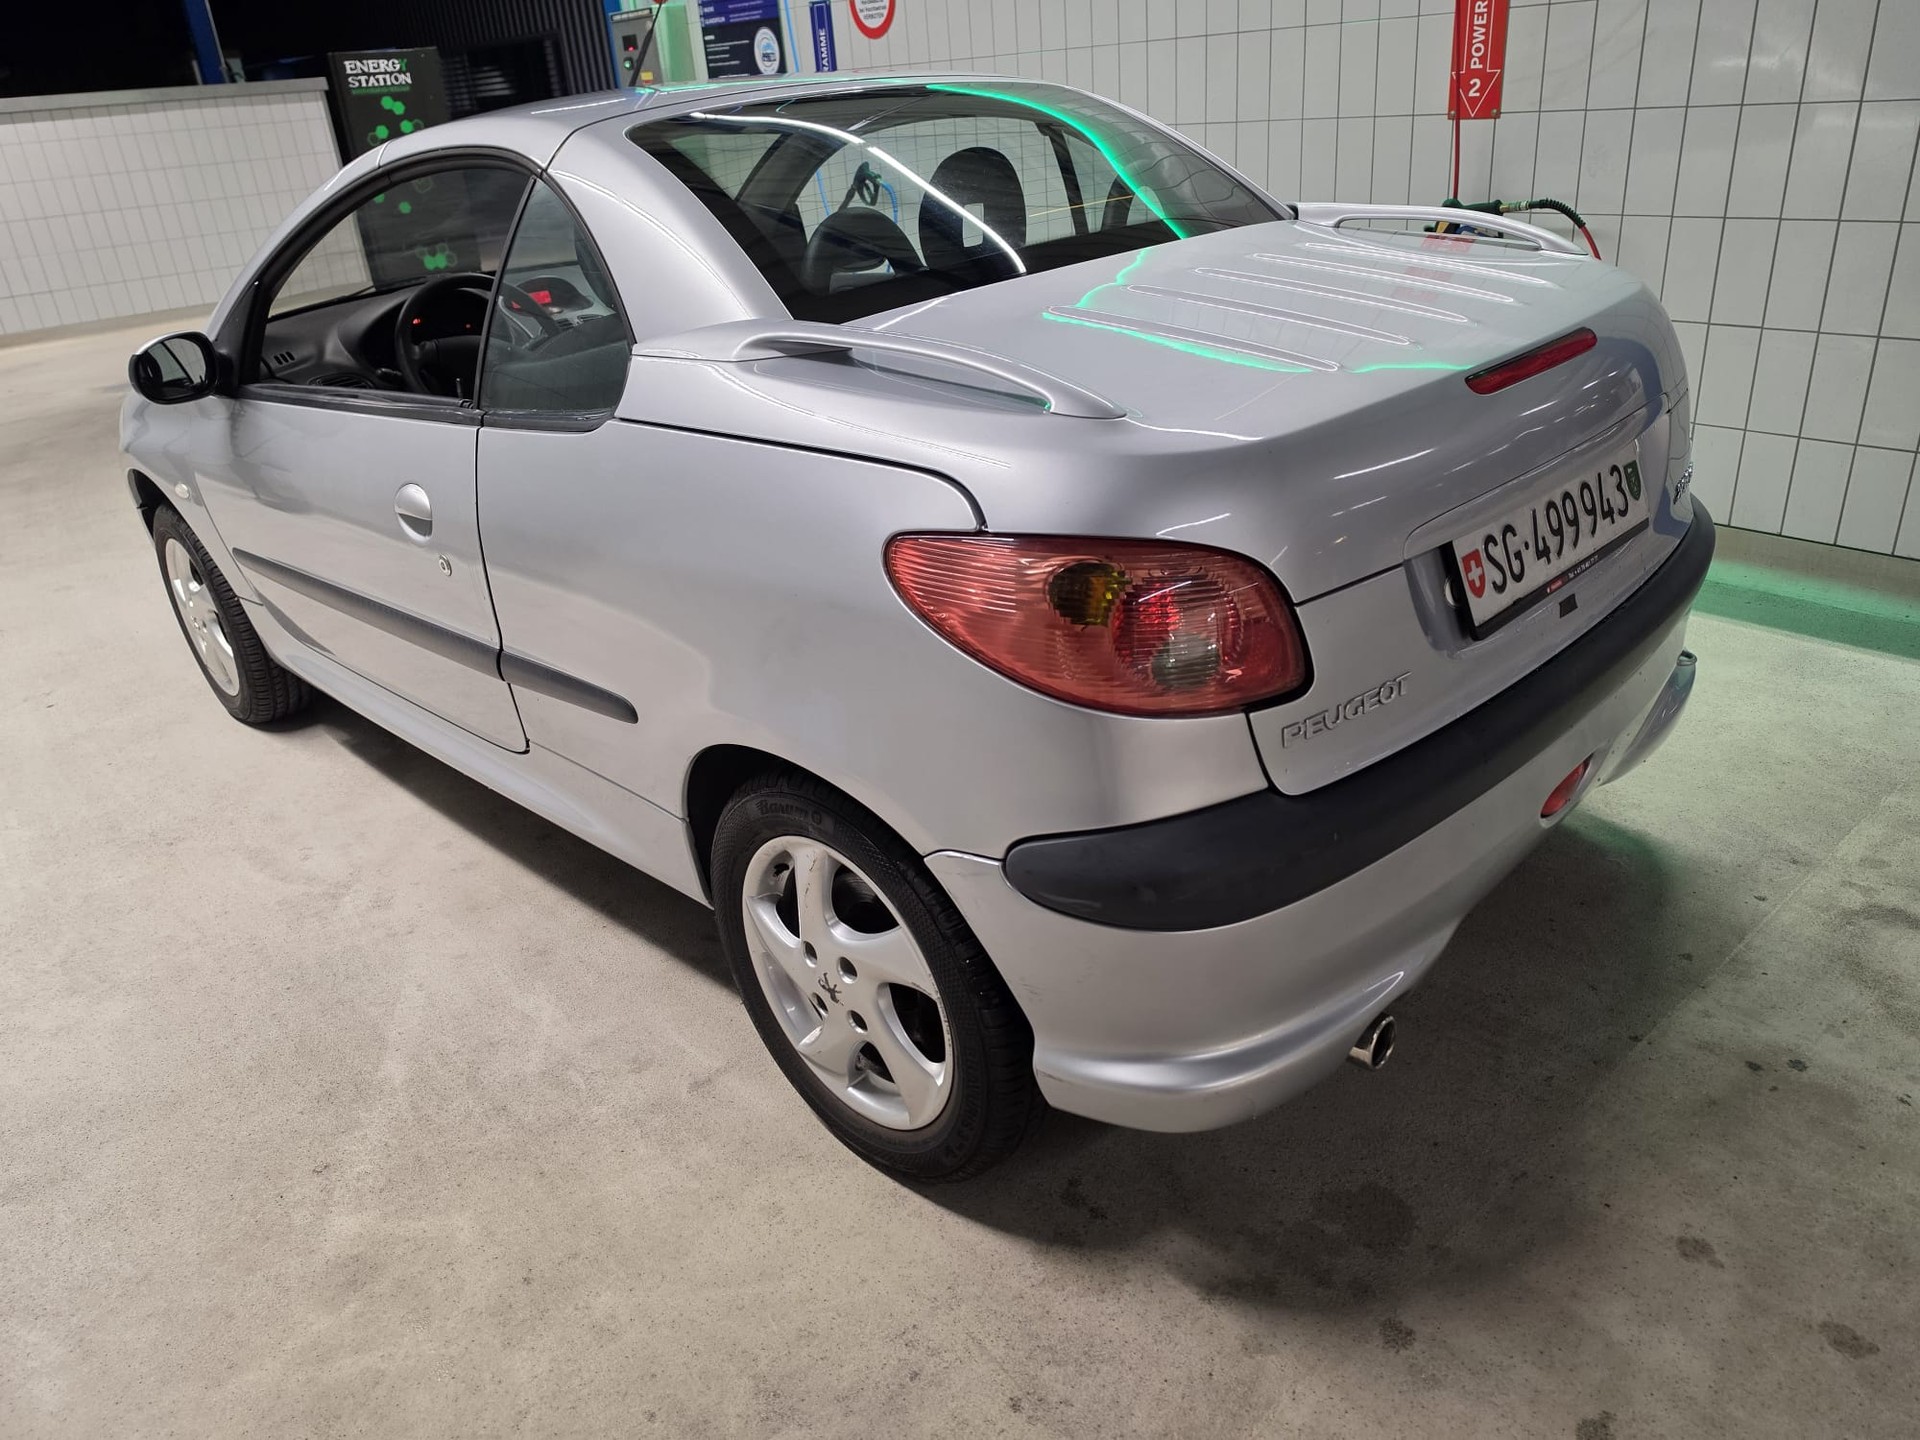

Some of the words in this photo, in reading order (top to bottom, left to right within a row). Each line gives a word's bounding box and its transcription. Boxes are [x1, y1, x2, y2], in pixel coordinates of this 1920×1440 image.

[1470, 1, 1488, 69] POWER
[344, 58, 407, 75] ENERGY
[348, 72, 412, 88] STATION
[1468, 78, 1481, 97] 2
[1281, 671, 1413, 749] PEUGEOT
